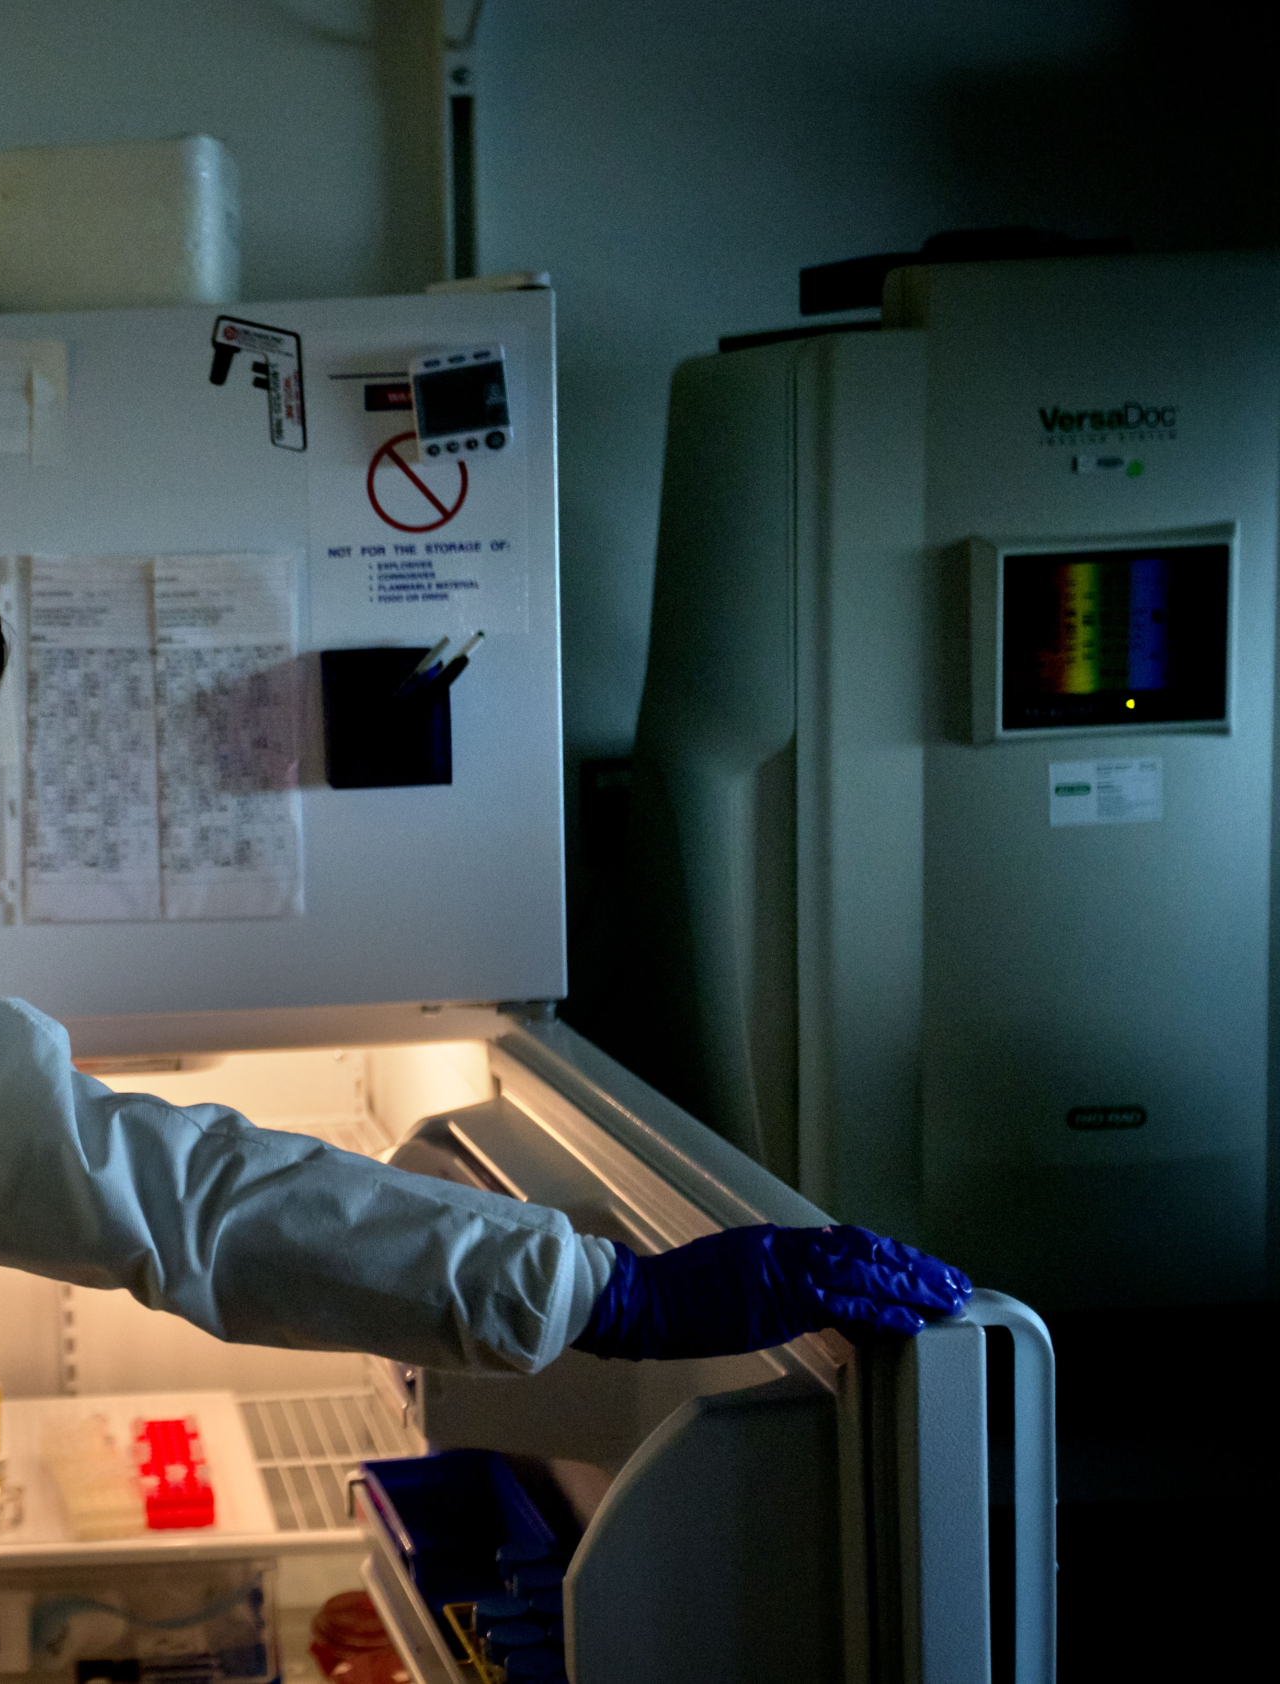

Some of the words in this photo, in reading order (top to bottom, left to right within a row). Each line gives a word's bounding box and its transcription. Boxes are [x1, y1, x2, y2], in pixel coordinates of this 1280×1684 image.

[1039, 402, 1176, 432] VersaDoc
[328, 547, 351, 558] NOT
[361, 545, 385, 556] FOR
[394, 544, 416, 555] THE
[425, 541, 481, 554] STORAGE
